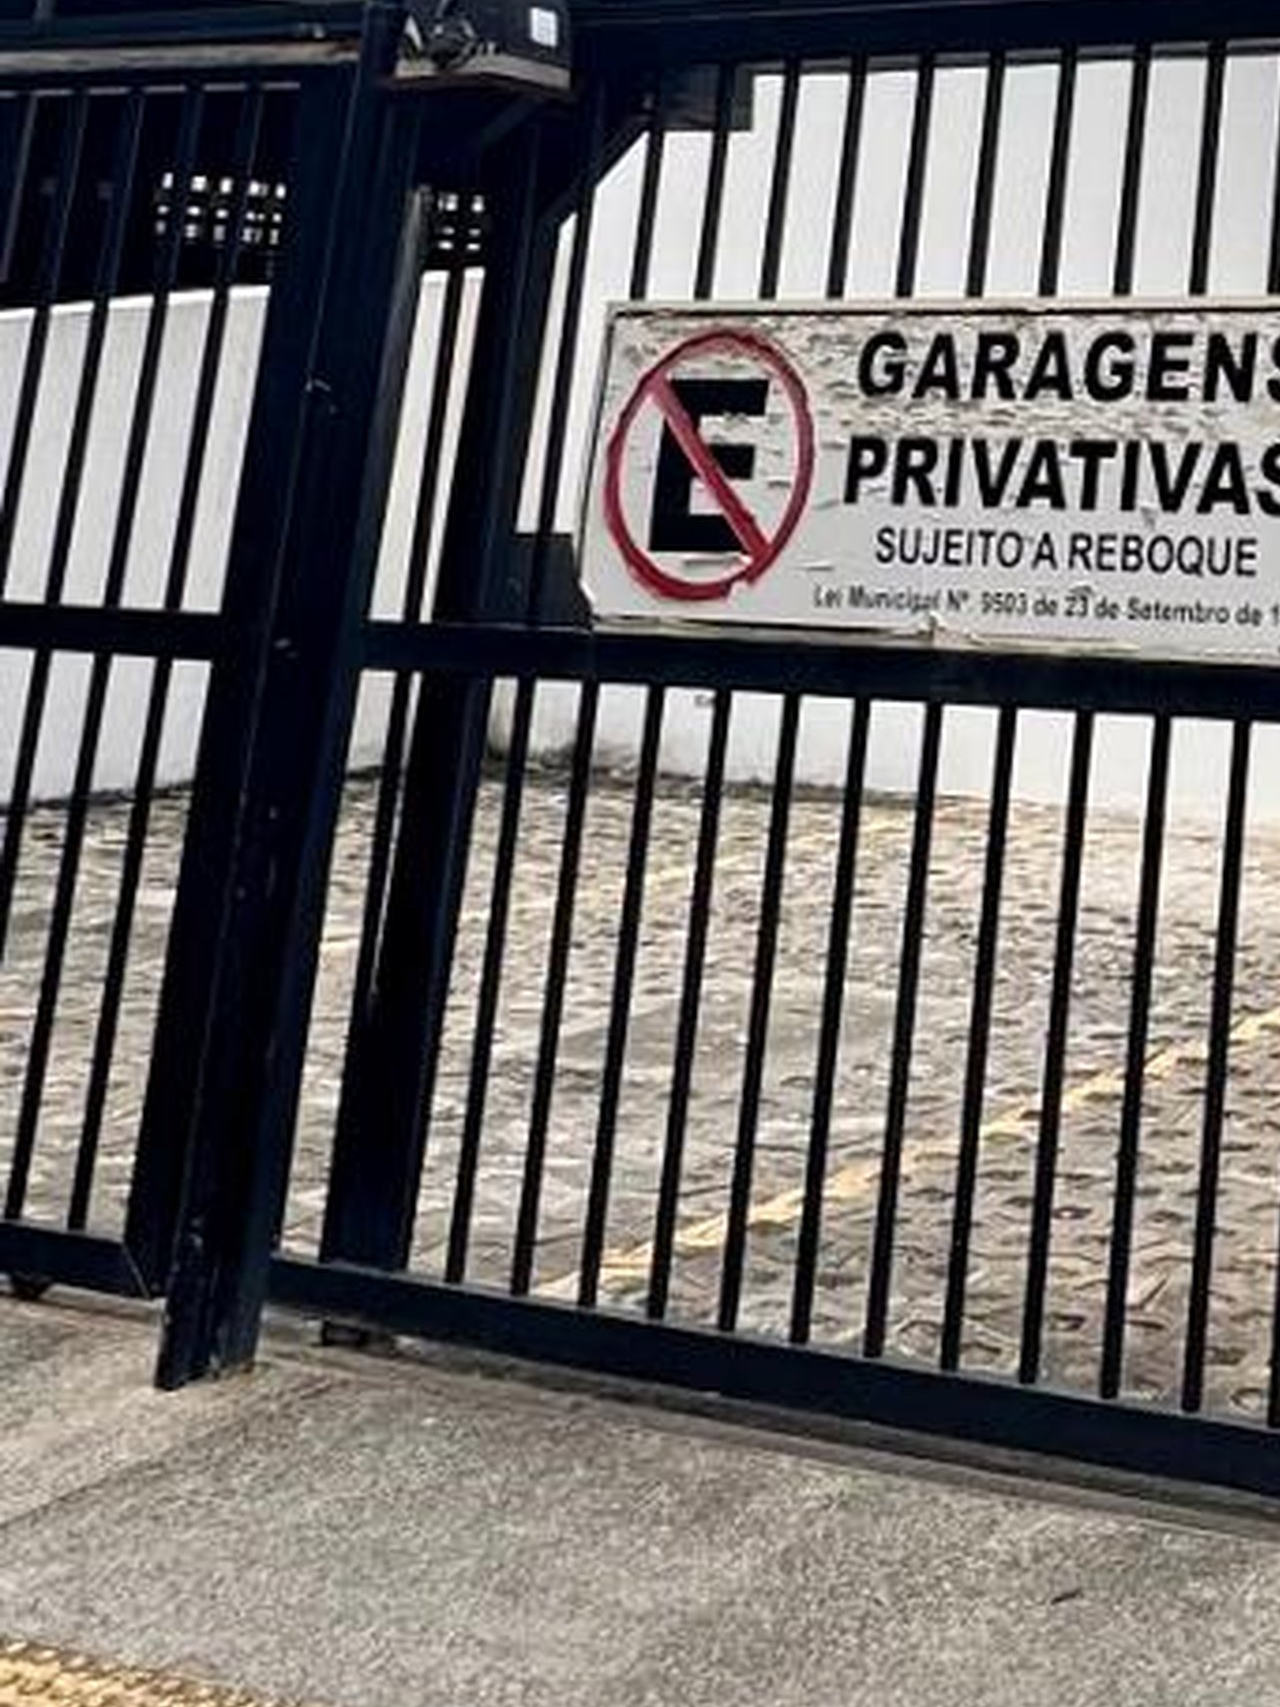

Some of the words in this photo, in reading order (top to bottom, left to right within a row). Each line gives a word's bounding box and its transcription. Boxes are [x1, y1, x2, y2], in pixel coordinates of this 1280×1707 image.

[875, 527, 1024, 570] SUJEITO
[1032, 532, 1059, 571] A
[1068, 532, 1259, 579] REBOQUE
[848, 585, 941, 615] Municipal
[1033, 593, 1058, 617] de
[1064, 595, 1089, 619] 23
[1094, 597, 1120, 621] de
[1126, 595, 1231, 625] Setembro
[1234, 602, 1263, 627] de
